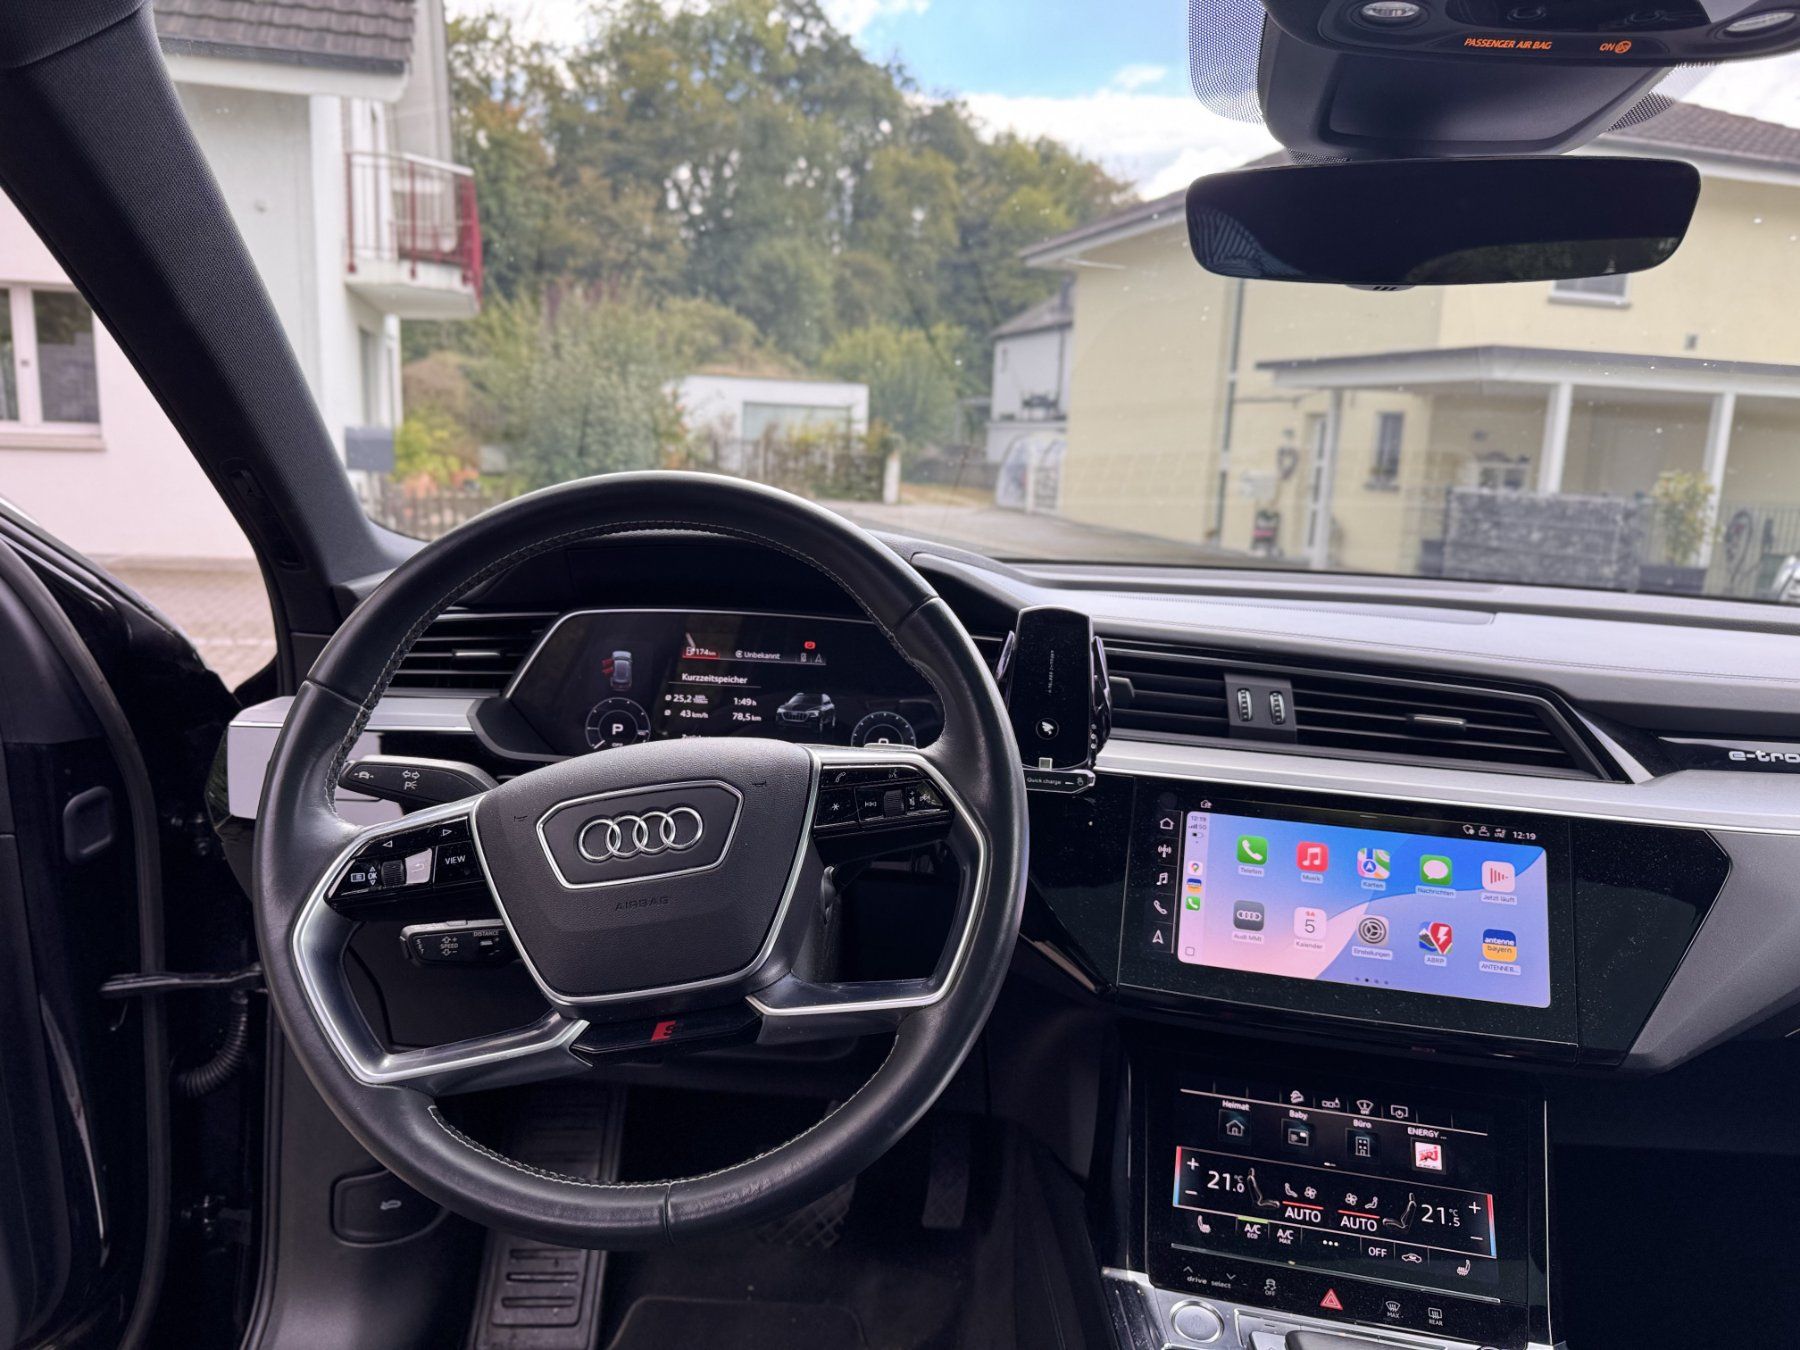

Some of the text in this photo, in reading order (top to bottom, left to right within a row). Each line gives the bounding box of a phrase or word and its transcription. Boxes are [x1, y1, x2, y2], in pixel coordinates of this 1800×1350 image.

[1464, 38, 1552, 50] PASSENGER AIR BAG
[1600, 42, 1615, 51] ON
[696, 649, 708, 657] 174
[744, 651, 780, 660] Unbekannt
[682, 673, 748, 685] Kurzzeitspeicher
[673, 693, 692, 703] 25,2
[733, 697, 752, 706] 1:49
[680, 709, 709, 719] 43 km/h
[733, 711, 762, 722] 78,5 km
[612, 723, 624, 736] P
[1513, 831, 1537, 840] 12:19
[445, 855, 466, 865] VIEW
[368, 872, 378, 880] OK
[1240, 867, 1263, 876] Telefon
[1302, 874, 1321, 882] Musik
[1363, 881, 1384, 889] Karten
[1418, 887, 1455, 897] Nachrichten
[615, 896, 669, 911] AIRBAG
[1304, 919, 1316, 934] 5
[473, 929, 499, 937] DISTANCE
[1234, 933, 1248, 941] Audi
[1296, 941, 1323, 950] Kalender
[1485, 937, 1515, 946] antenne
[1487, 945, 1512, 954] bayern
[1222, 1100, 1250, 1111] Heimat
[1289, 1110, 1308, 1121] Baby
[1353, 1118, 1372, 1129] Büro
[1407, 1126, 1440, 1138] ENERGY
[1207, 1170, 1245, 1193] 21.0
[1284, 1207, 1321, 1223] AUTO
[1421, 1204, 1461, 1227] 21.5
[1244, 1223, 1262, 1234] A/C
[1341, 1215, 1377, 1232] AUTO
[1277, 1228, 1294, 1240] A/C
[1368, 1246, 1387, 1257] OFF
[1187, 1275, 1231, 1289] drive select
